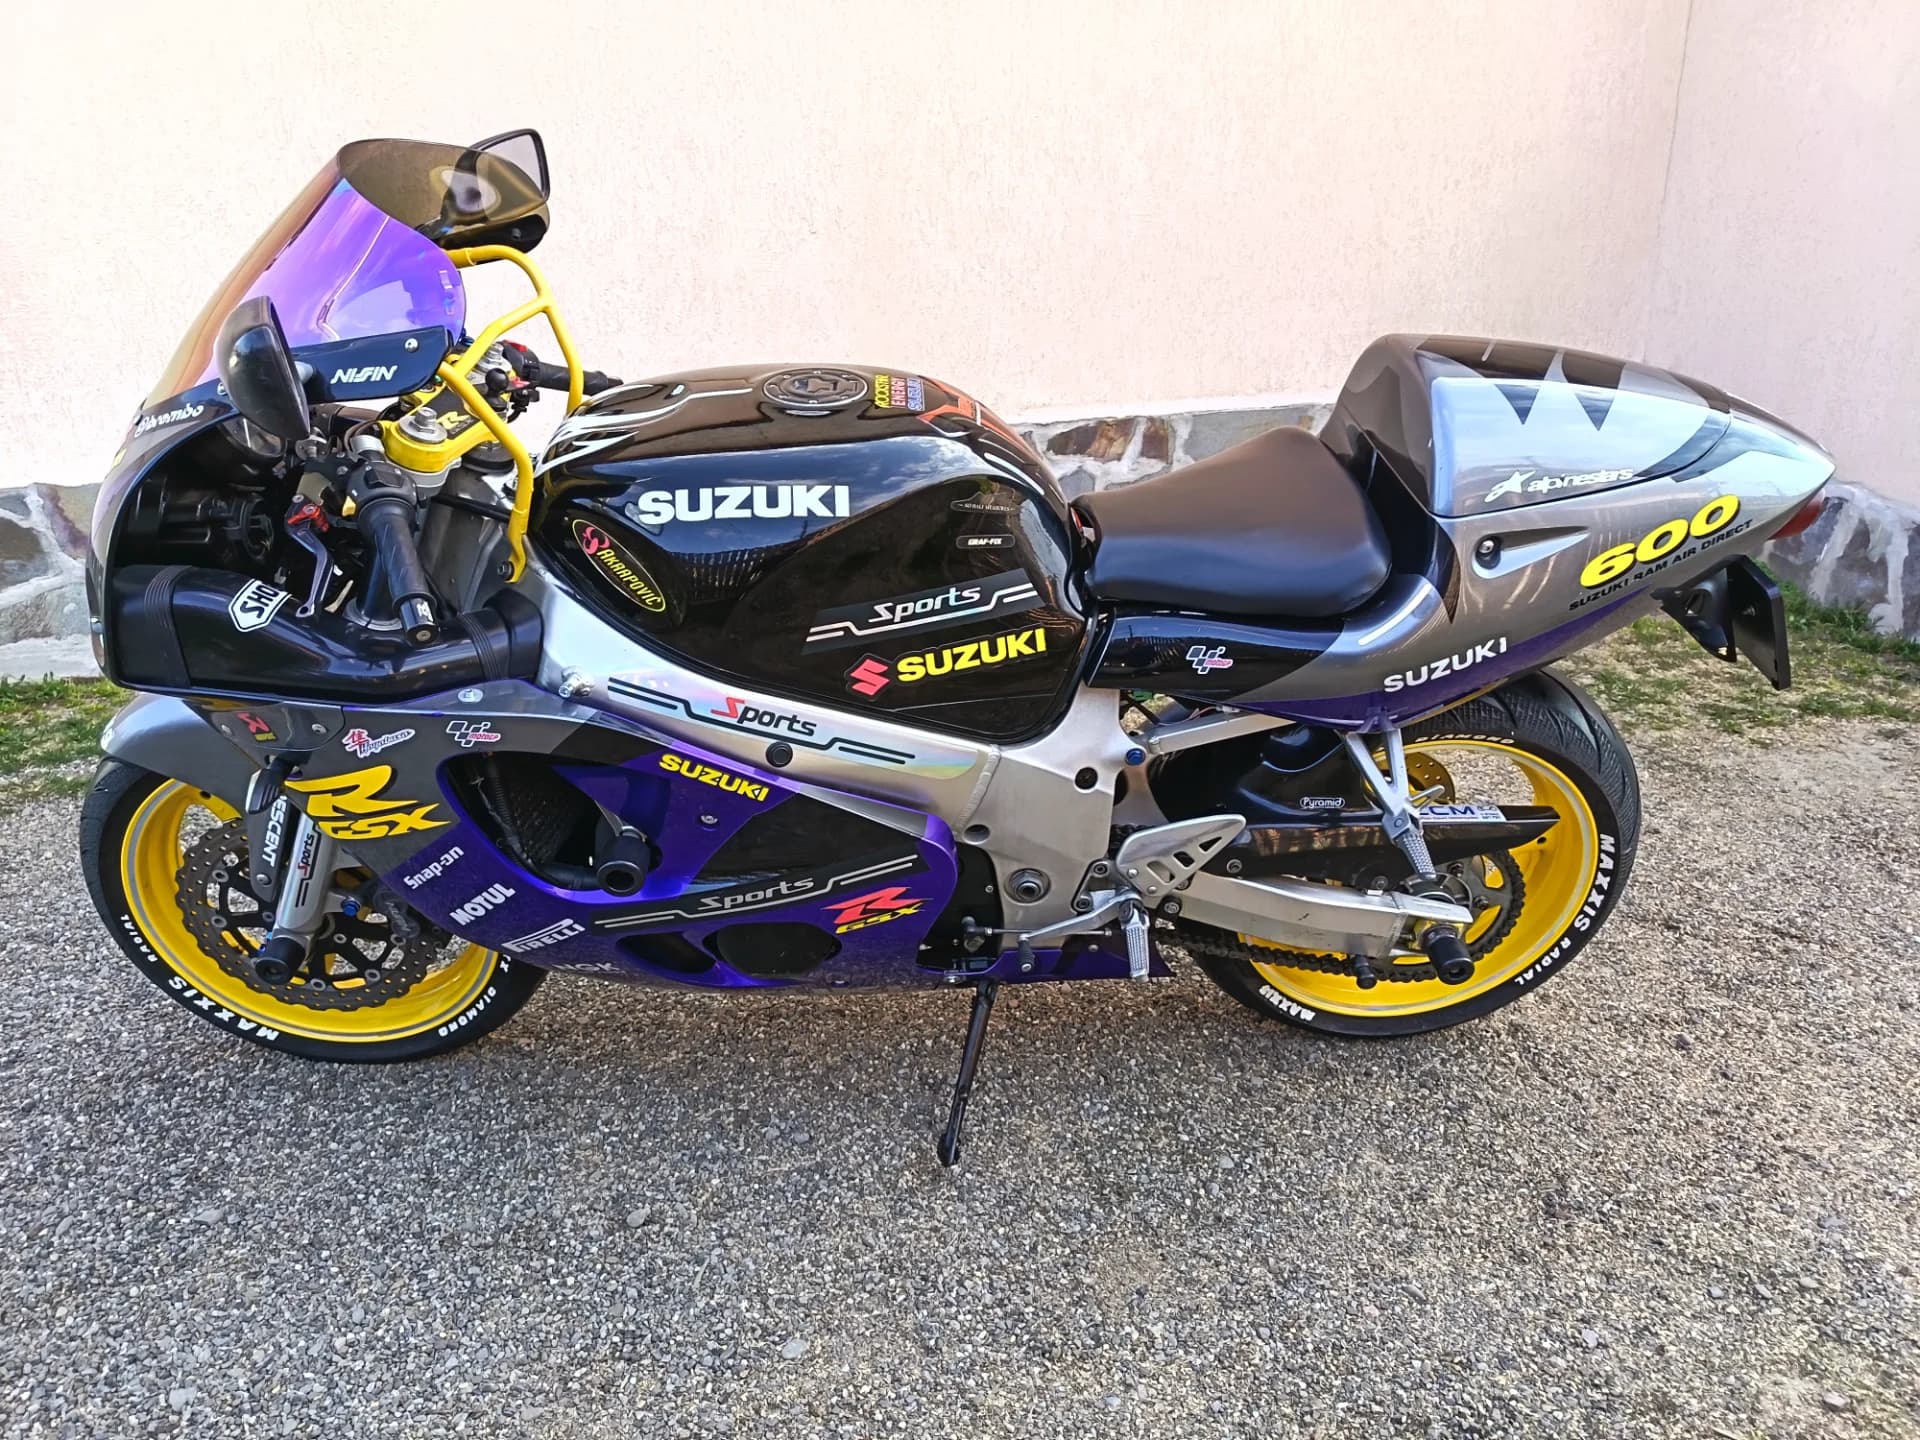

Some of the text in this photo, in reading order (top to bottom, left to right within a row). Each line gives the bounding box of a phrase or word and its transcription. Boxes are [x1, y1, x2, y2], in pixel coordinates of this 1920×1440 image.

[330, 366, 398, 384] NISSIN
[891, 378, 906, 407] ENERGY
[1527, 468, 1634, 494] alpinestars
[638, 485, 850, 525] SUZUKI
[1580, 494, 1740, 588] 600
[1568, 519, 1753, 611] SUZUKI RAM AIR DIRECT
[867, 586, 981, 624] Sports
[897, 628, 1047, 683] SUZUKI
[1383, 637, 1508, 693] SUZUKI
[711, 697, 817, 736] Sports
[1415, 734, 1515, 744] DIAMOND
[659, 753, 770, 802] SUZUKI
[318, 803, 452, 840] GSX
[1303, 797, 1342, 809] Pyramid
[262, 795, 288, 867] ESCENT
[297, 833, 315, 877] Sports
[450, 882, 516, 926] MOTUL
[698, 877, 814, 910] Sports
[1514, 833, 1616, 985] MAXXIS RADIAL
[502, 918, 586, 953] PIRELLI
[120, 914, 280, 1041] MAXXIS RADIAL
[437, 986, 497, 1037] DIAMOND
